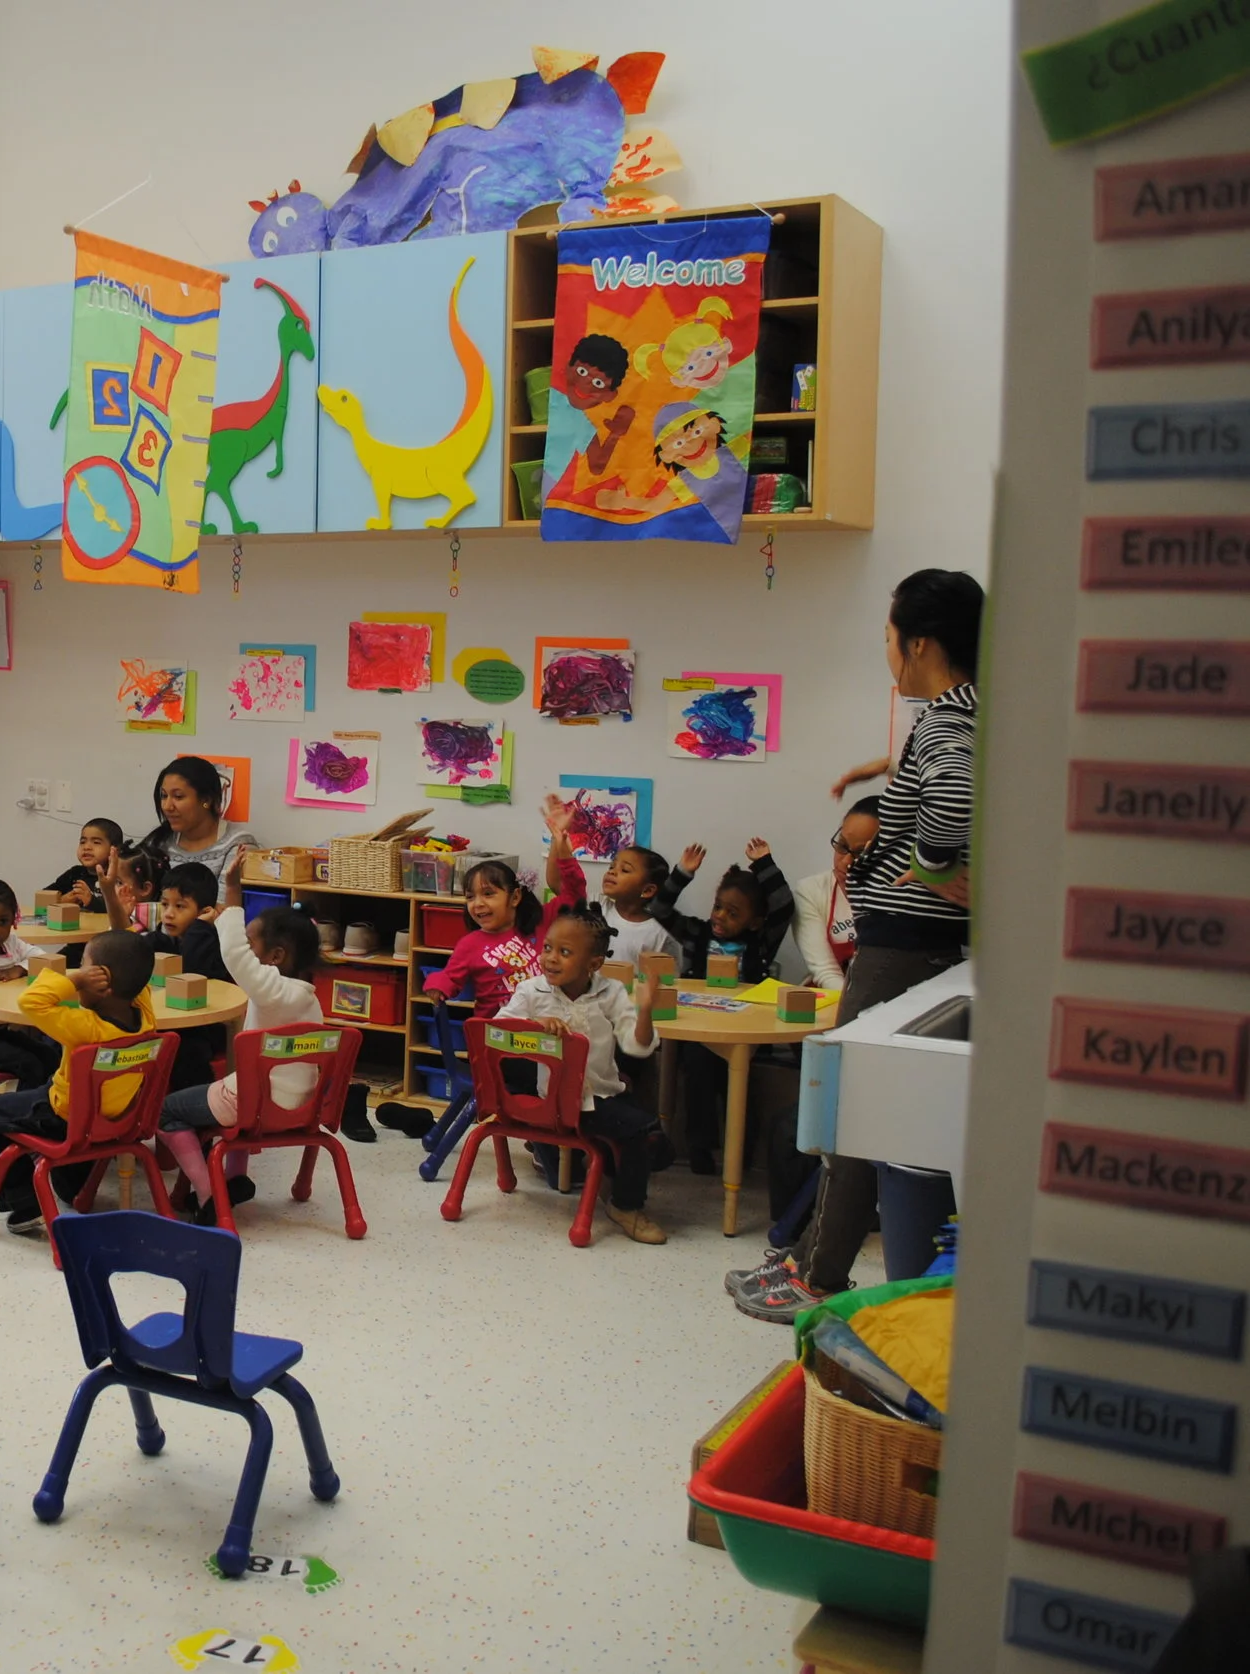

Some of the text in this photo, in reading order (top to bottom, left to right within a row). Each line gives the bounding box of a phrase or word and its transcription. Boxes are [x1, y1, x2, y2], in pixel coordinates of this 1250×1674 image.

[591, 251, 746, 291] Welcome
[1130, 413, 1242, 456] Chris
[1121, 524, 1250, 568] Emile
[1126, 654, 1229, 693] Jade
[1094, 780, 1247, 831] Janelly
[1107, 904, 1225, 949] Jayce
[482, 935, 524, 967] EVERY
[286, 1040, 319, 1051] Amani
[1083, 1026, 1226, 1076] Kaylen
[1065, 1277, 1196, 1333] Makyi
[1050, 1383, 1198, 1445] Melbin
[1051, 1494, 1193, 1554] Michel
[1041, 1598, 1159, 1656] Omar
[203, 1638, 266, 1664] 17
